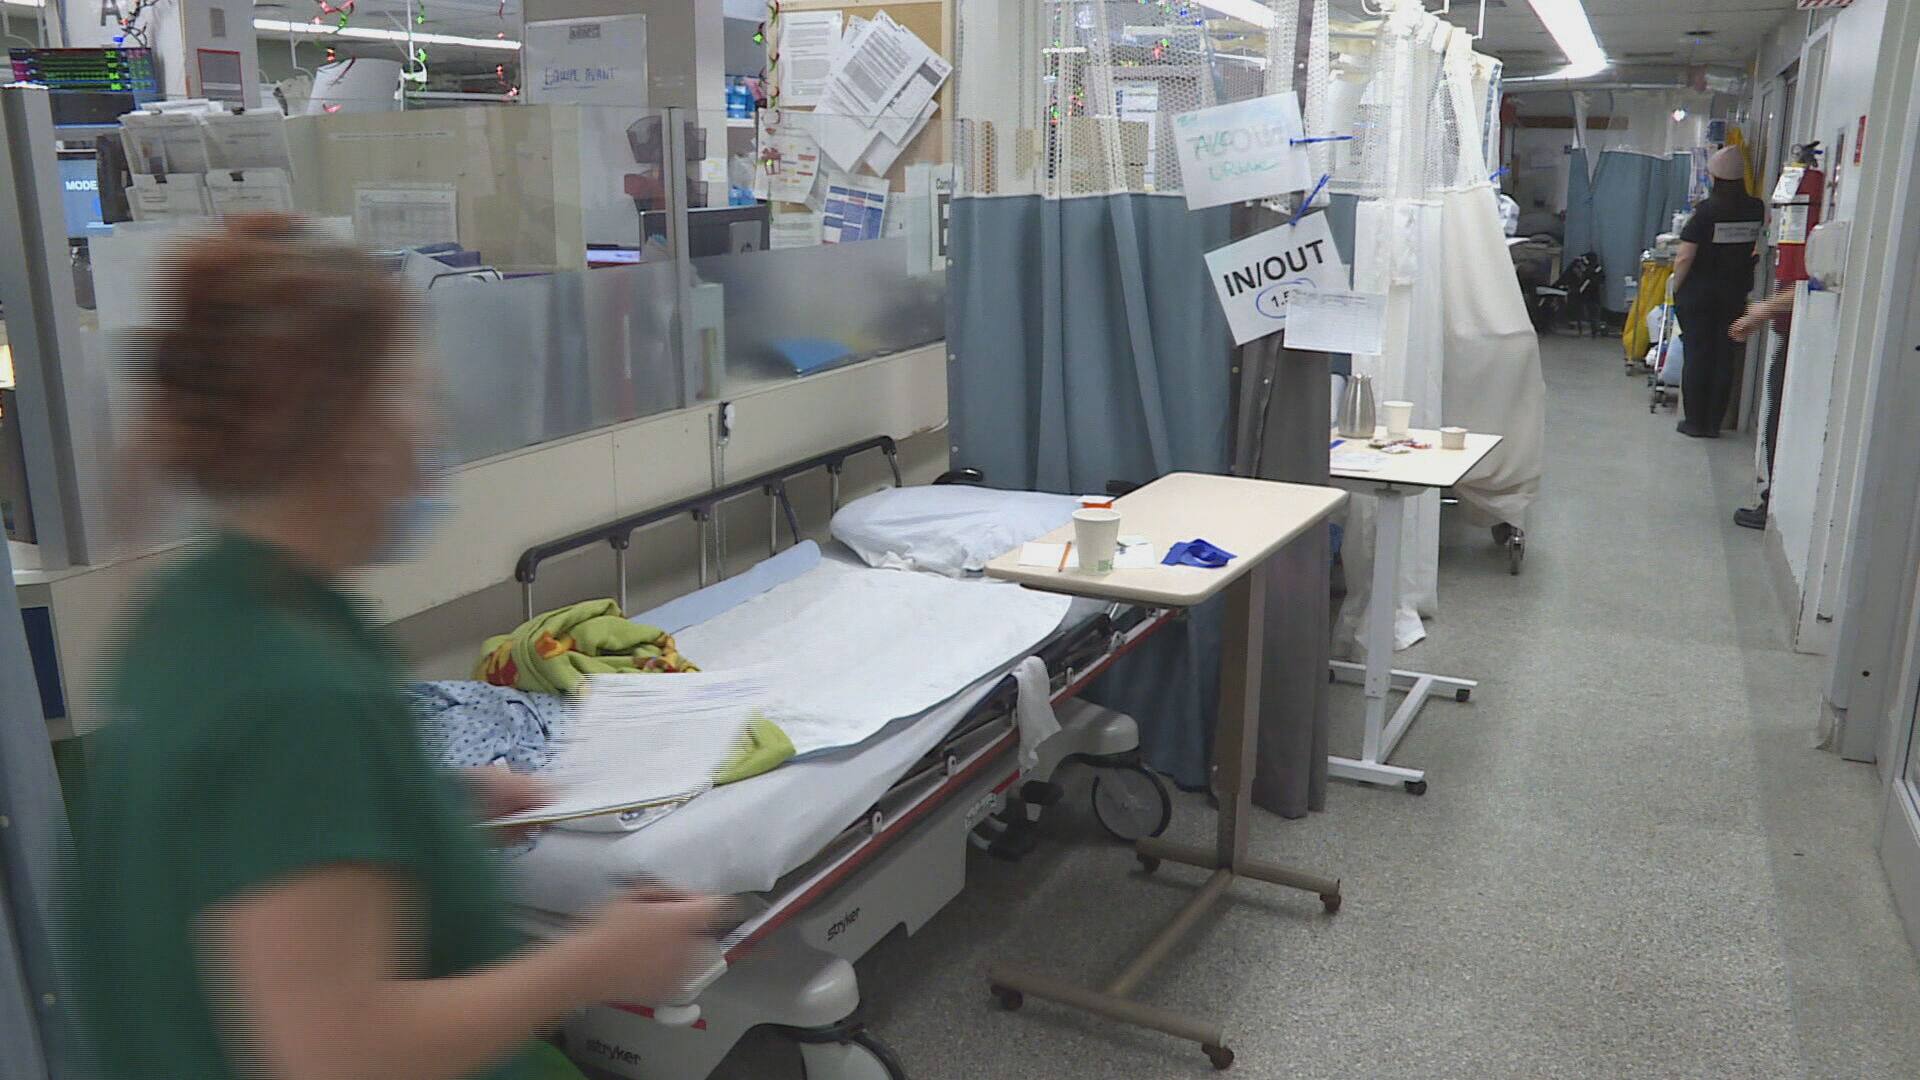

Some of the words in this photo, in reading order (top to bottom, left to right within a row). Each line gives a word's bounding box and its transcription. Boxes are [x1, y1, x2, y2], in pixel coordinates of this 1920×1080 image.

[65, 180, 99, 190] MODE
[1223, 239, 1324, 297] IN/OUT
[827, 907, 861, 941] stryker
[586, 1039, 642, 1065] stryker
